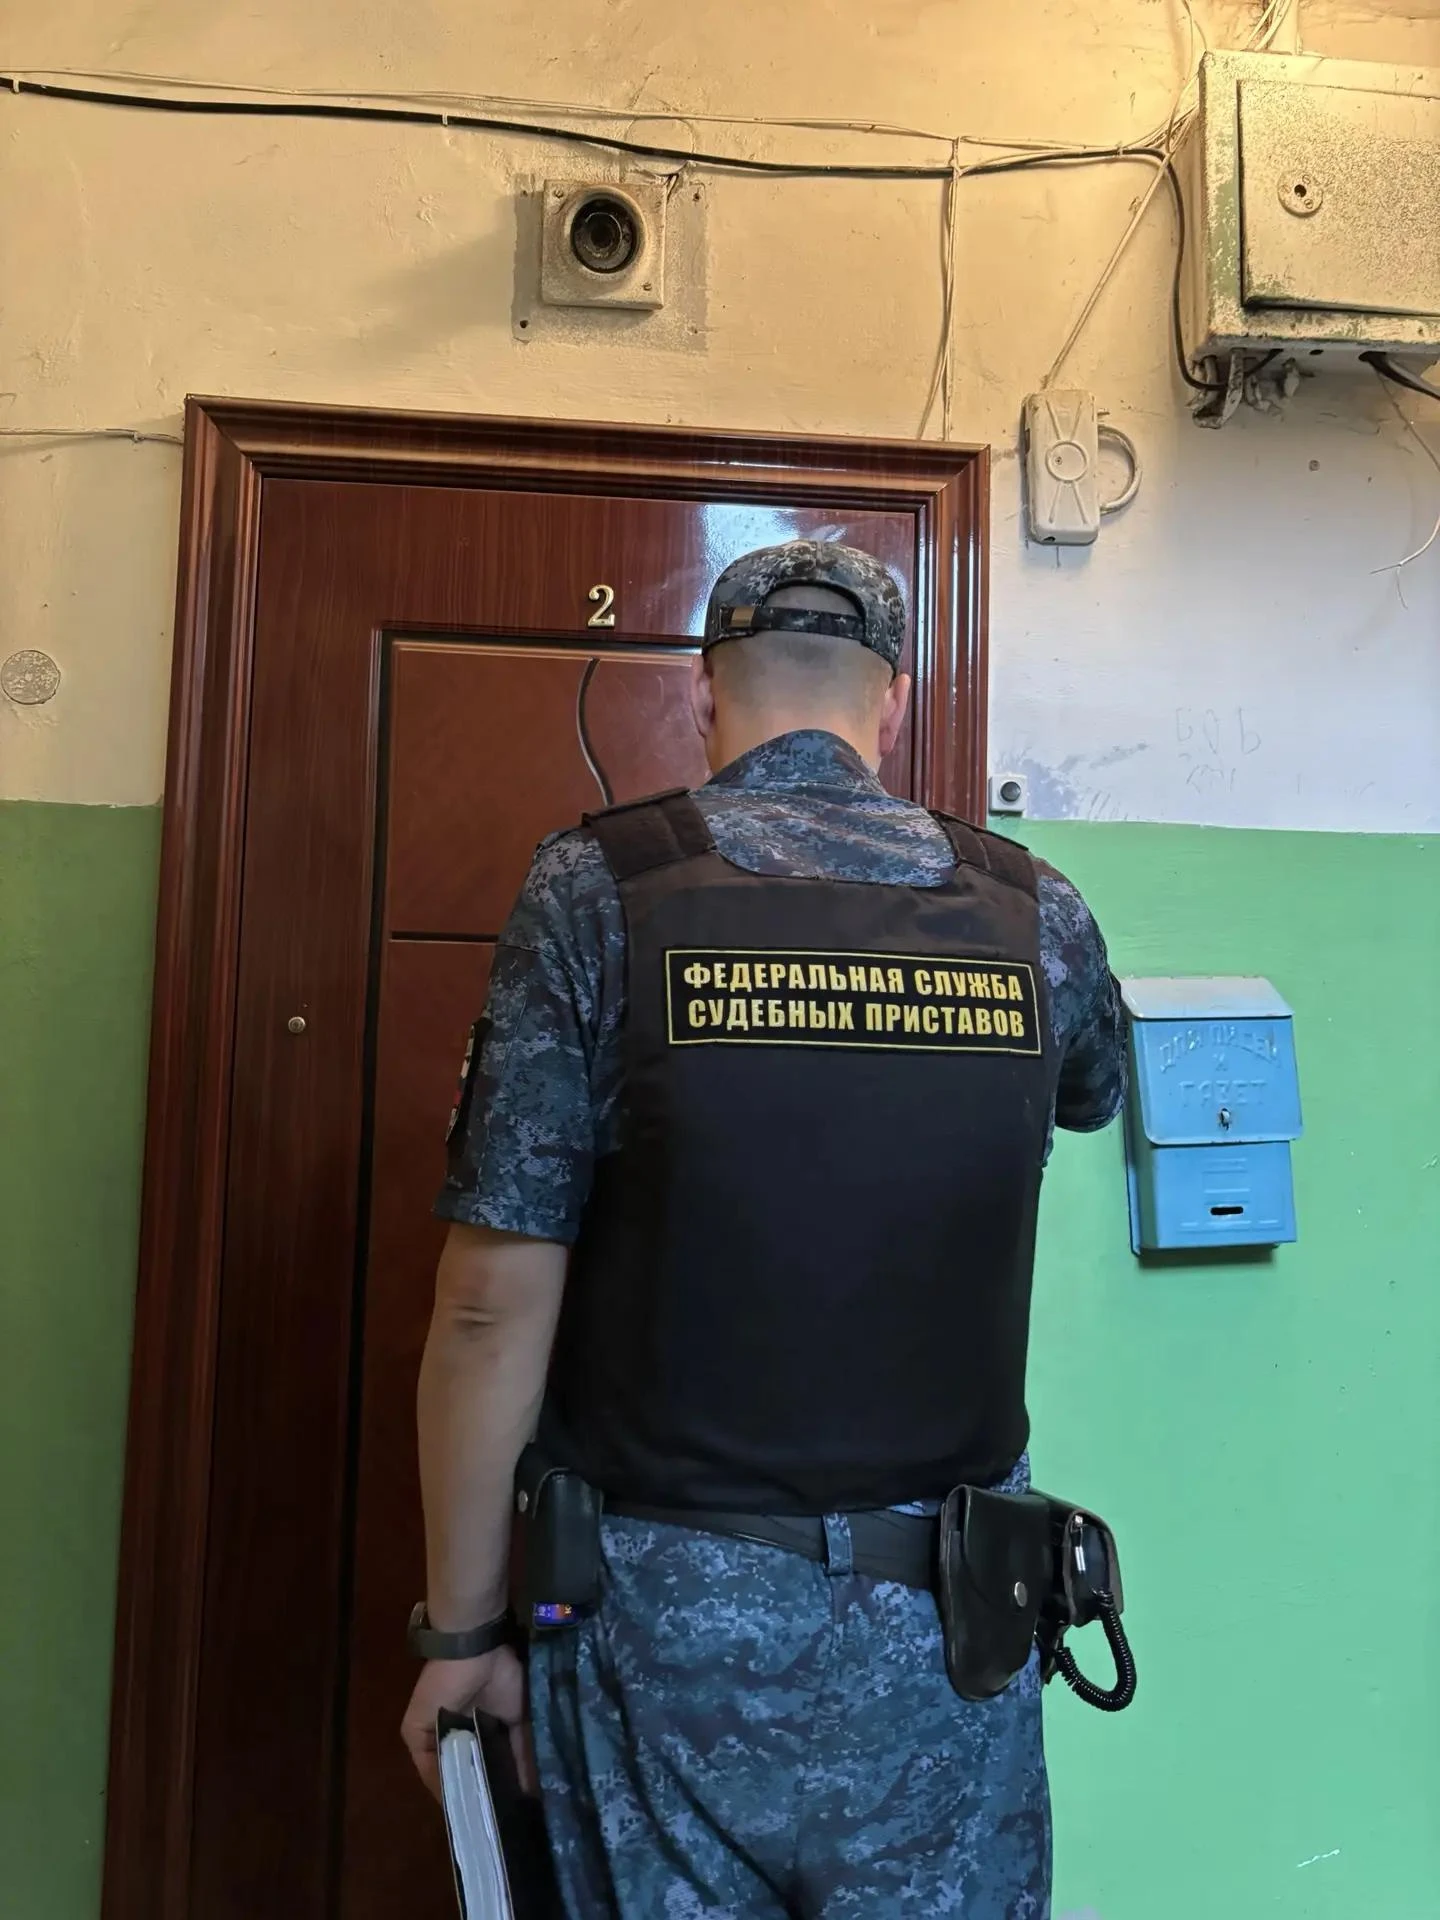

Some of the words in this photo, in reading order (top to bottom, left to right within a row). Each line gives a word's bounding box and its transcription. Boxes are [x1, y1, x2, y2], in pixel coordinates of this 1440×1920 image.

[588, 584, 615, 626] 2
[683, 962, 904, 994] ФЕДЕРАЛЬНАЯ
[914, 969, 1024, 1001] СЛУЖБА
[688, 998, 855, 1031] СУДЕБНЫХ
[865, 1002, 1025, 1037] ПРИСТАВОВ
